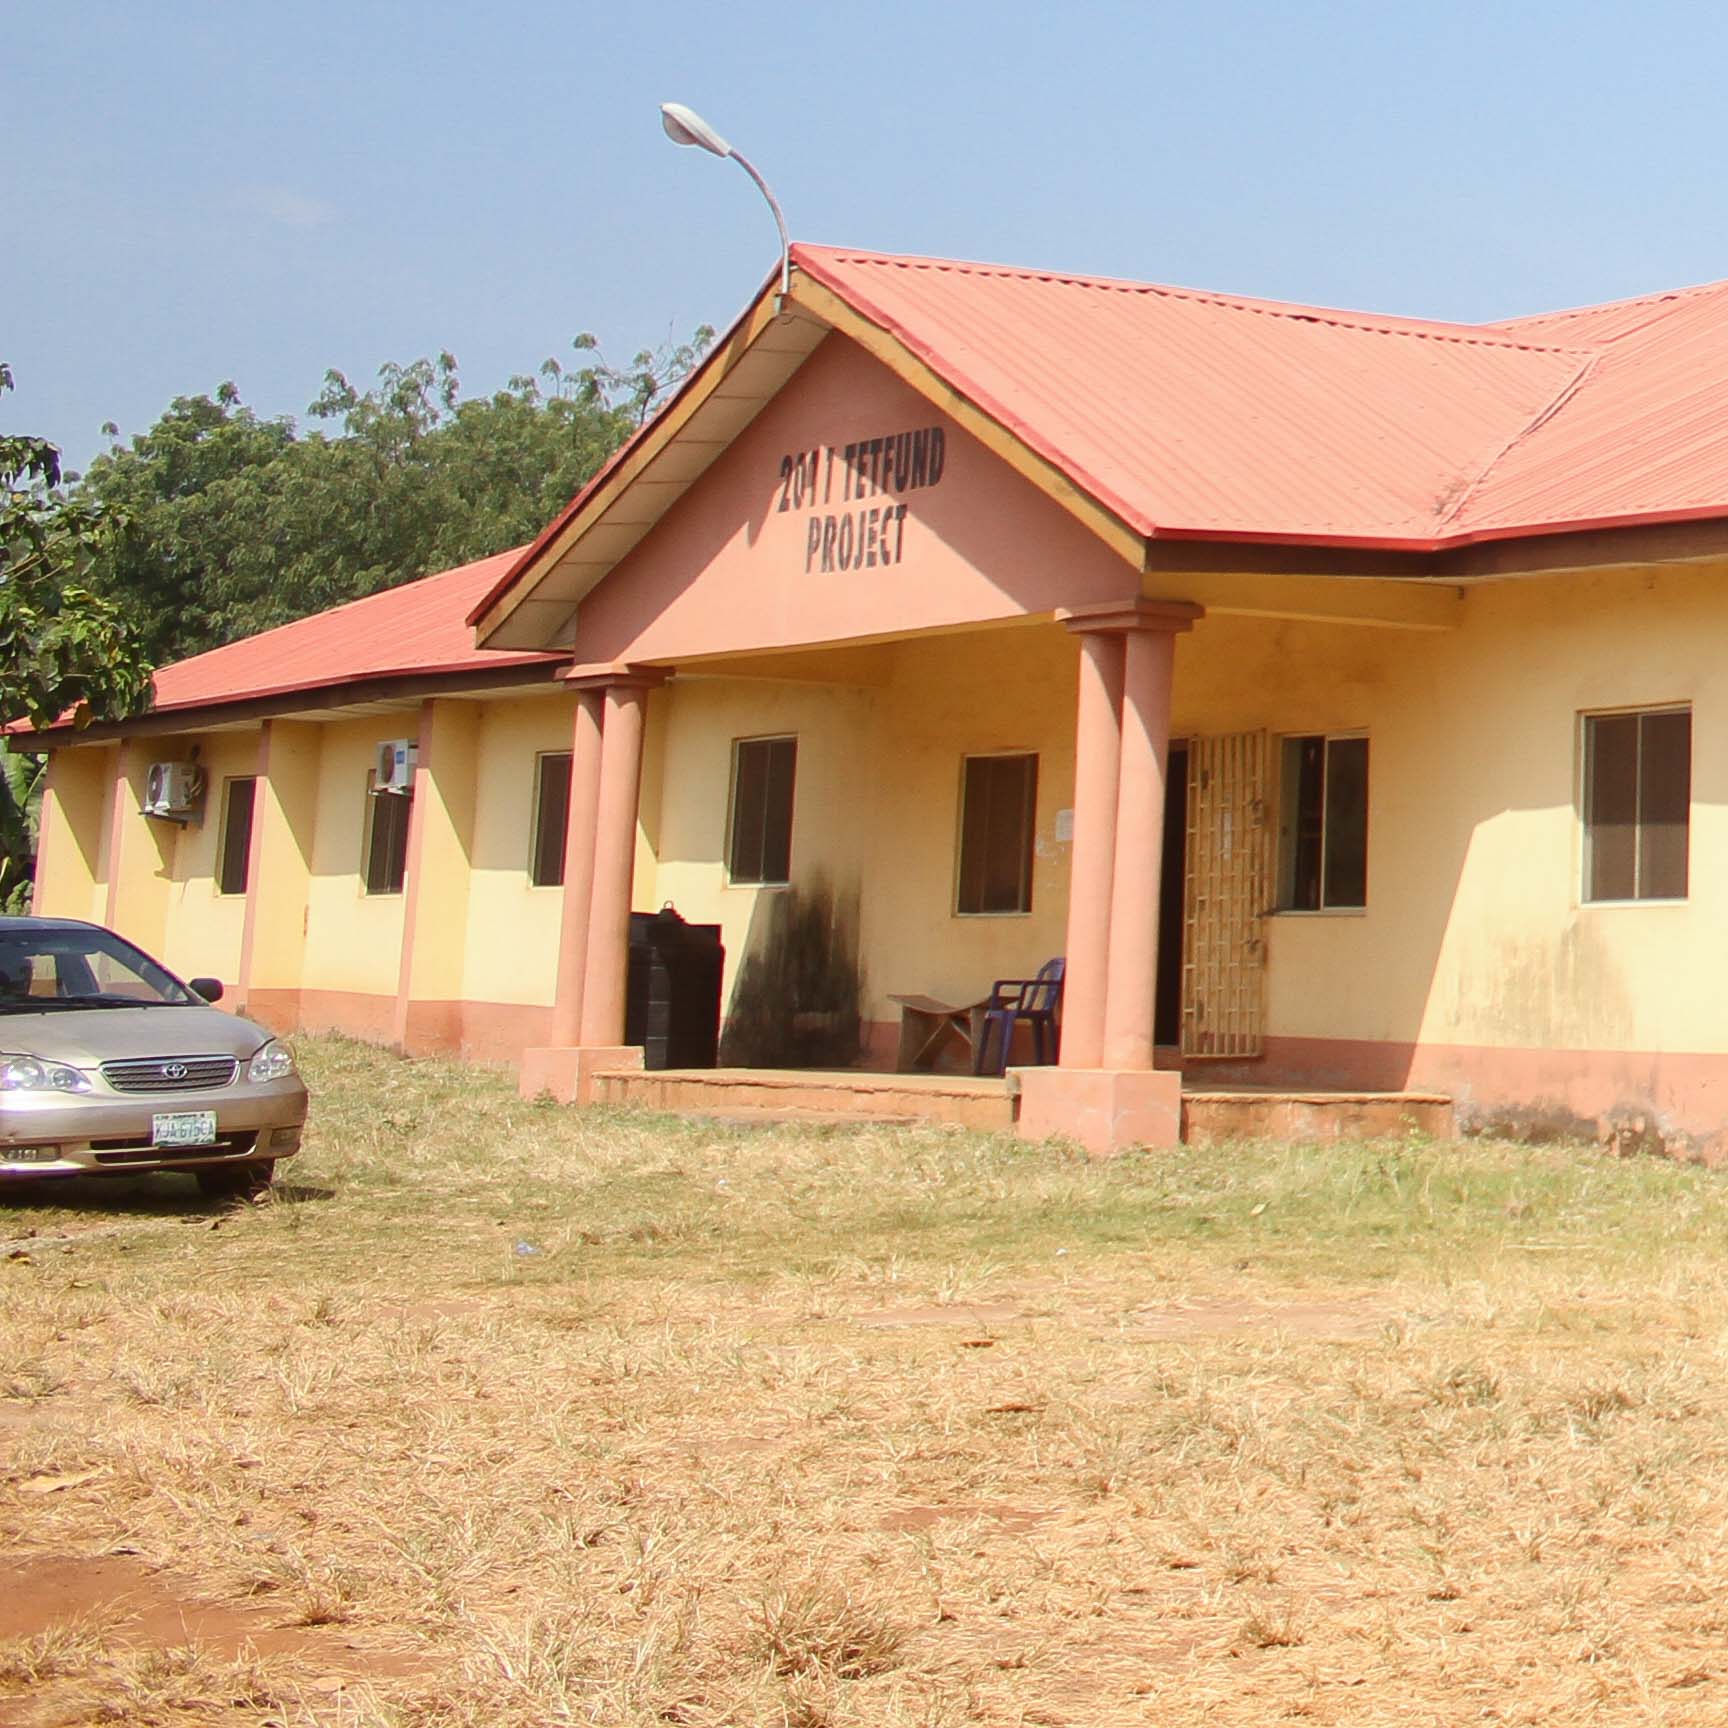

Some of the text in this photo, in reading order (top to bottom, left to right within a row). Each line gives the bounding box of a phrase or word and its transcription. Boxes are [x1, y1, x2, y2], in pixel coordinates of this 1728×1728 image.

[777, 427, 945, 513] 2011 TETFUND
[805, 504, 908, 573] PROJECT
